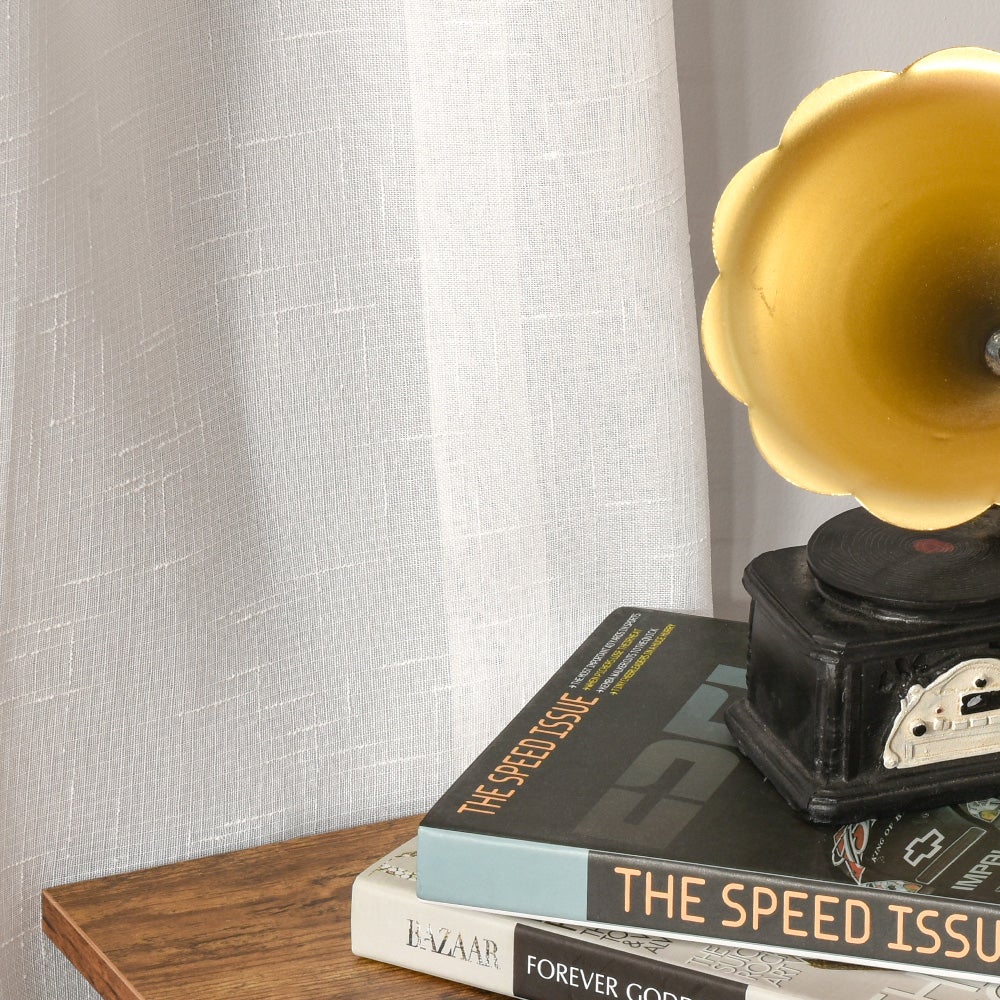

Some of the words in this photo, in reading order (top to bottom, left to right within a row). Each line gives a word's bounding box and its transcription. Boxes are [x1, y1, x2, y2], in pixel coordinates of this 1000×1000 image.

[624, 614, 641, 626] SPORTS
[457, 784, 516, 815] THE
[488, 738, 557, 786] SPEED
[529, 692, 600, 739] ISSUE
[614, 866, 706, 923] THE
[721, 882, 871, 945] SPEED
[405, 918, 501, 970] BAZAAR
[527, 955, 618, 998] FOREVER
